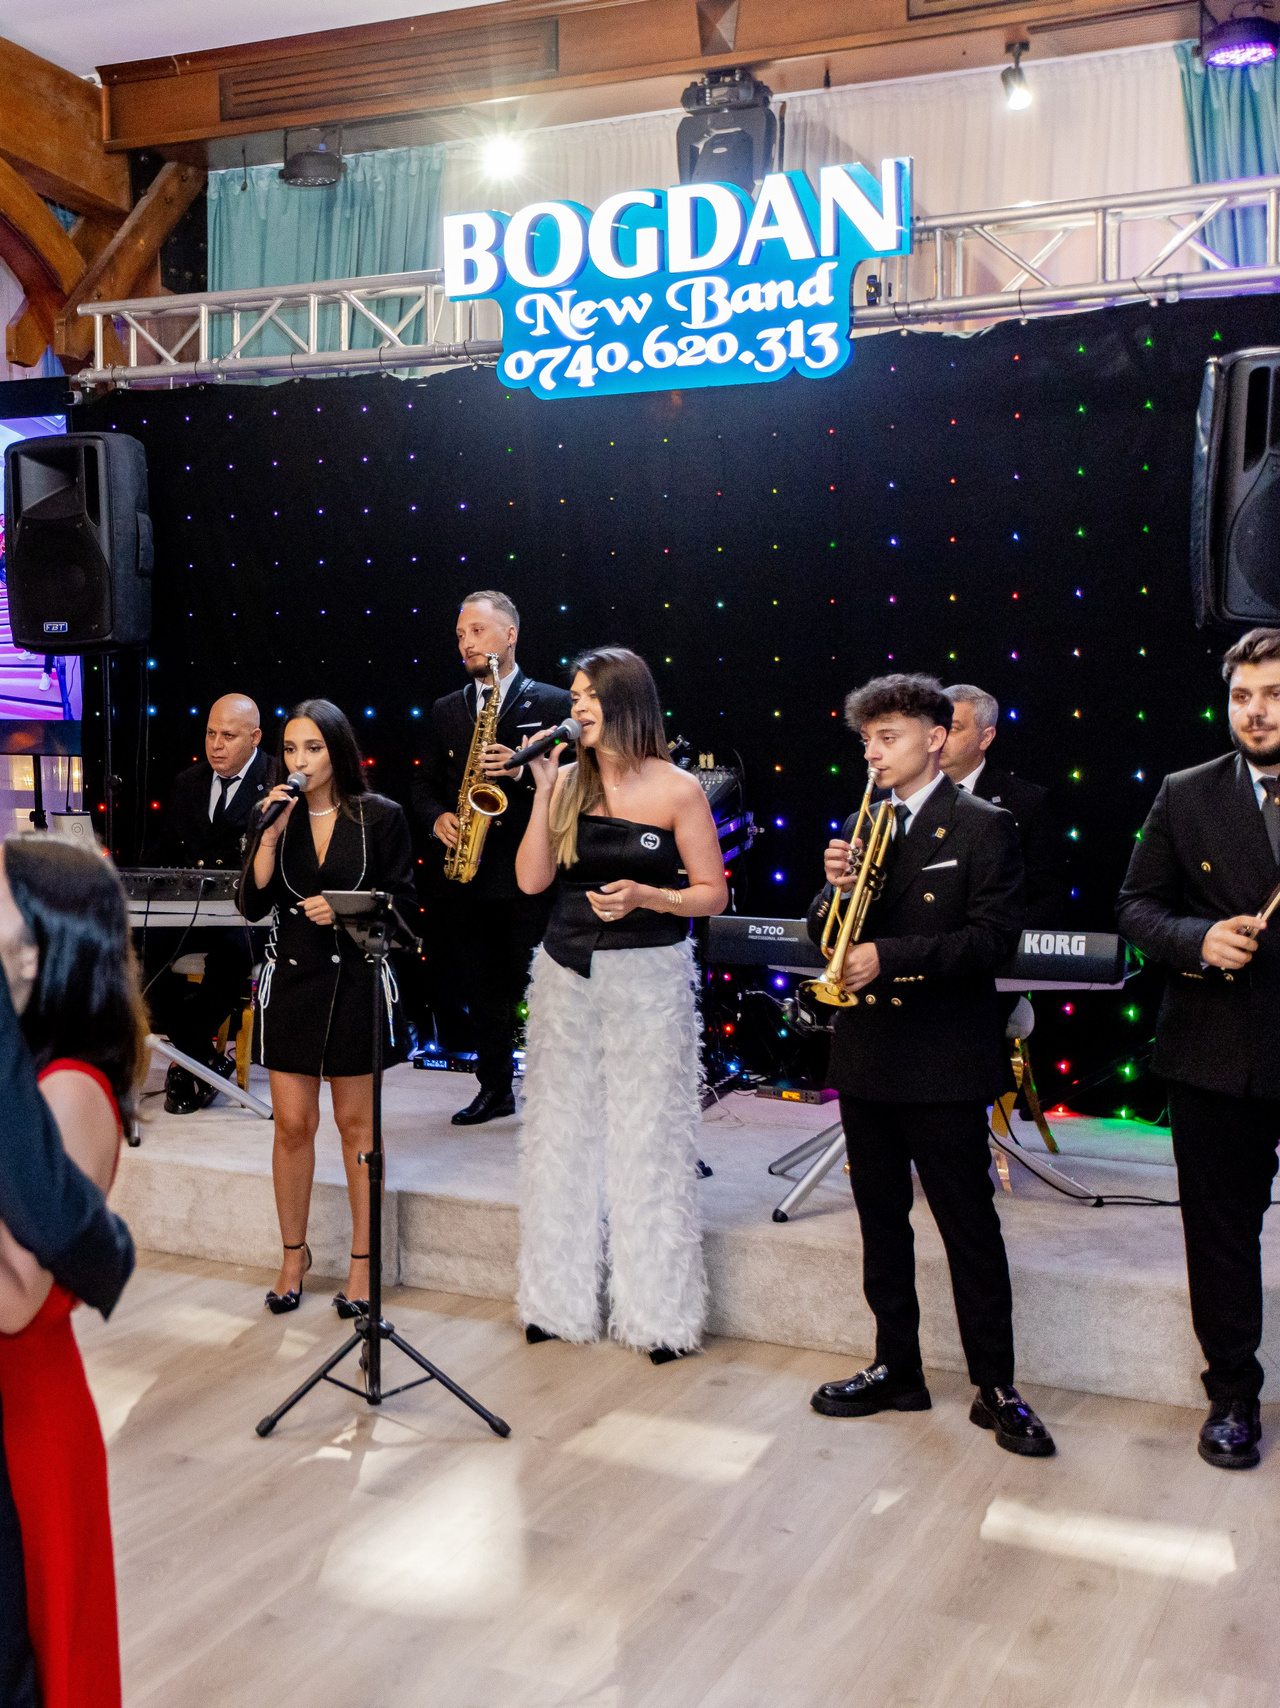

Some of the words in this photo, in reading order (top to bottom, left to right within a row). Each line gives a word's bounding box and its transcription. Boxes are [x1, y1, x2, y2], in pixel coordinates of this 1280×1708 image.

[443, 158, 903, 296] BOGDAN
[516, 292, 652, 340] New
[667, 262, 838, 329] Band
[504, 319, 838, 390] 0740.620.313
[45, 623, 66, 631] FBT
[748, 925, 785, 935] Pa700
[1024, 933, 1086, 956] KORG
